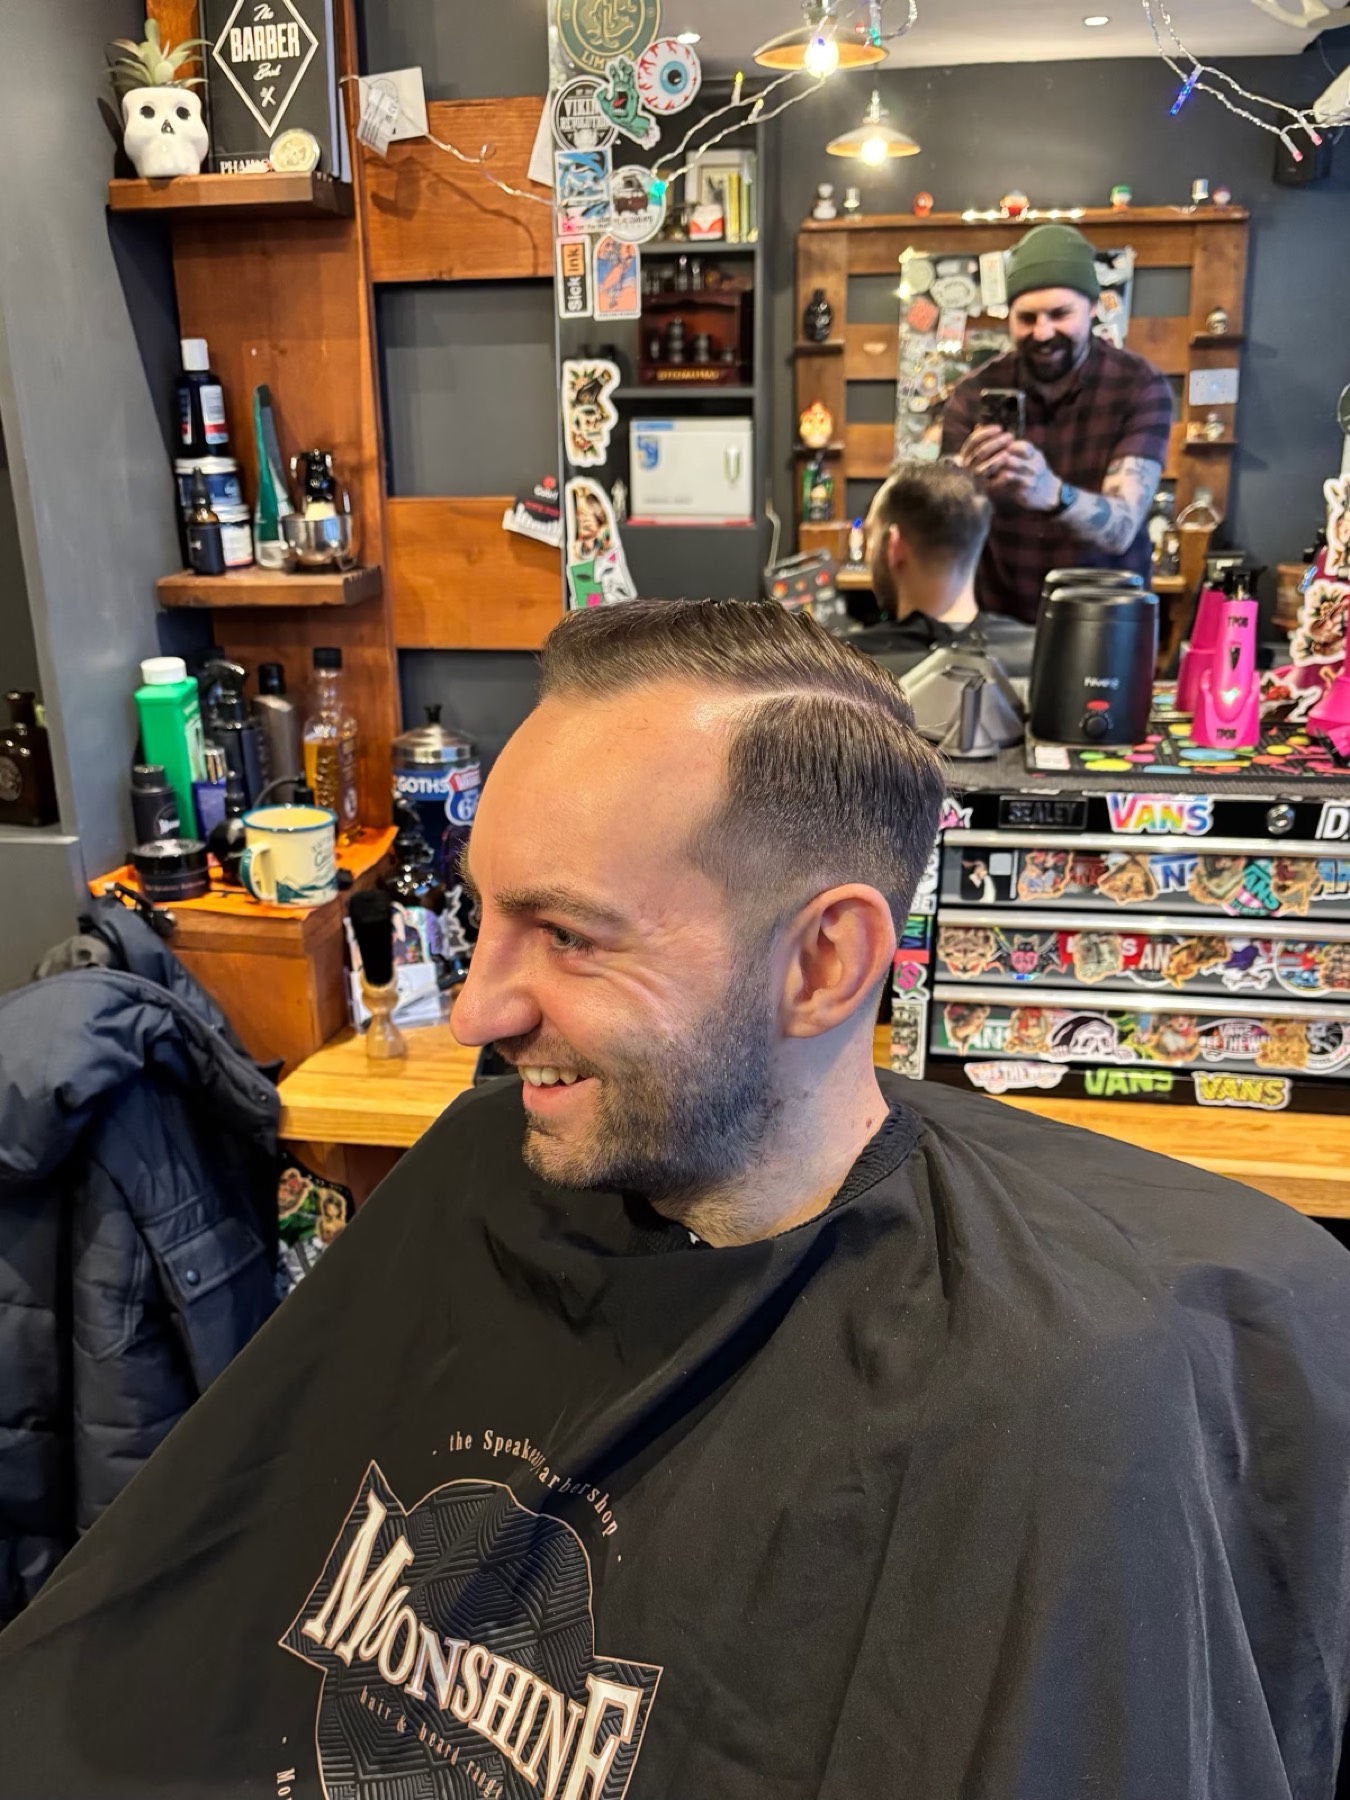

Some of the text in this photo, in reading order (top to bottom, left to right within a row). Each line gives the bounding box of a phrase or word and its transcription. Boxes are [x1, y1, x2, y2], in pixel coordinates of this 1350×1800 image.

[230, 21, 300, 63] BARBER
[1008, 800, 1077, 823] SEALEY
[1108, 792, 1209, 832] VANS
[1084, 1067, 1173, 1096] VANS
[1199, 1075, 1285, 1106] VANS
[449, 1431, 473, 1452] the
[538, 1465, 618, 1538] arbershop
[359, 1685, 393, 1721] hair
[418, 1721, 461, 1766] beard
